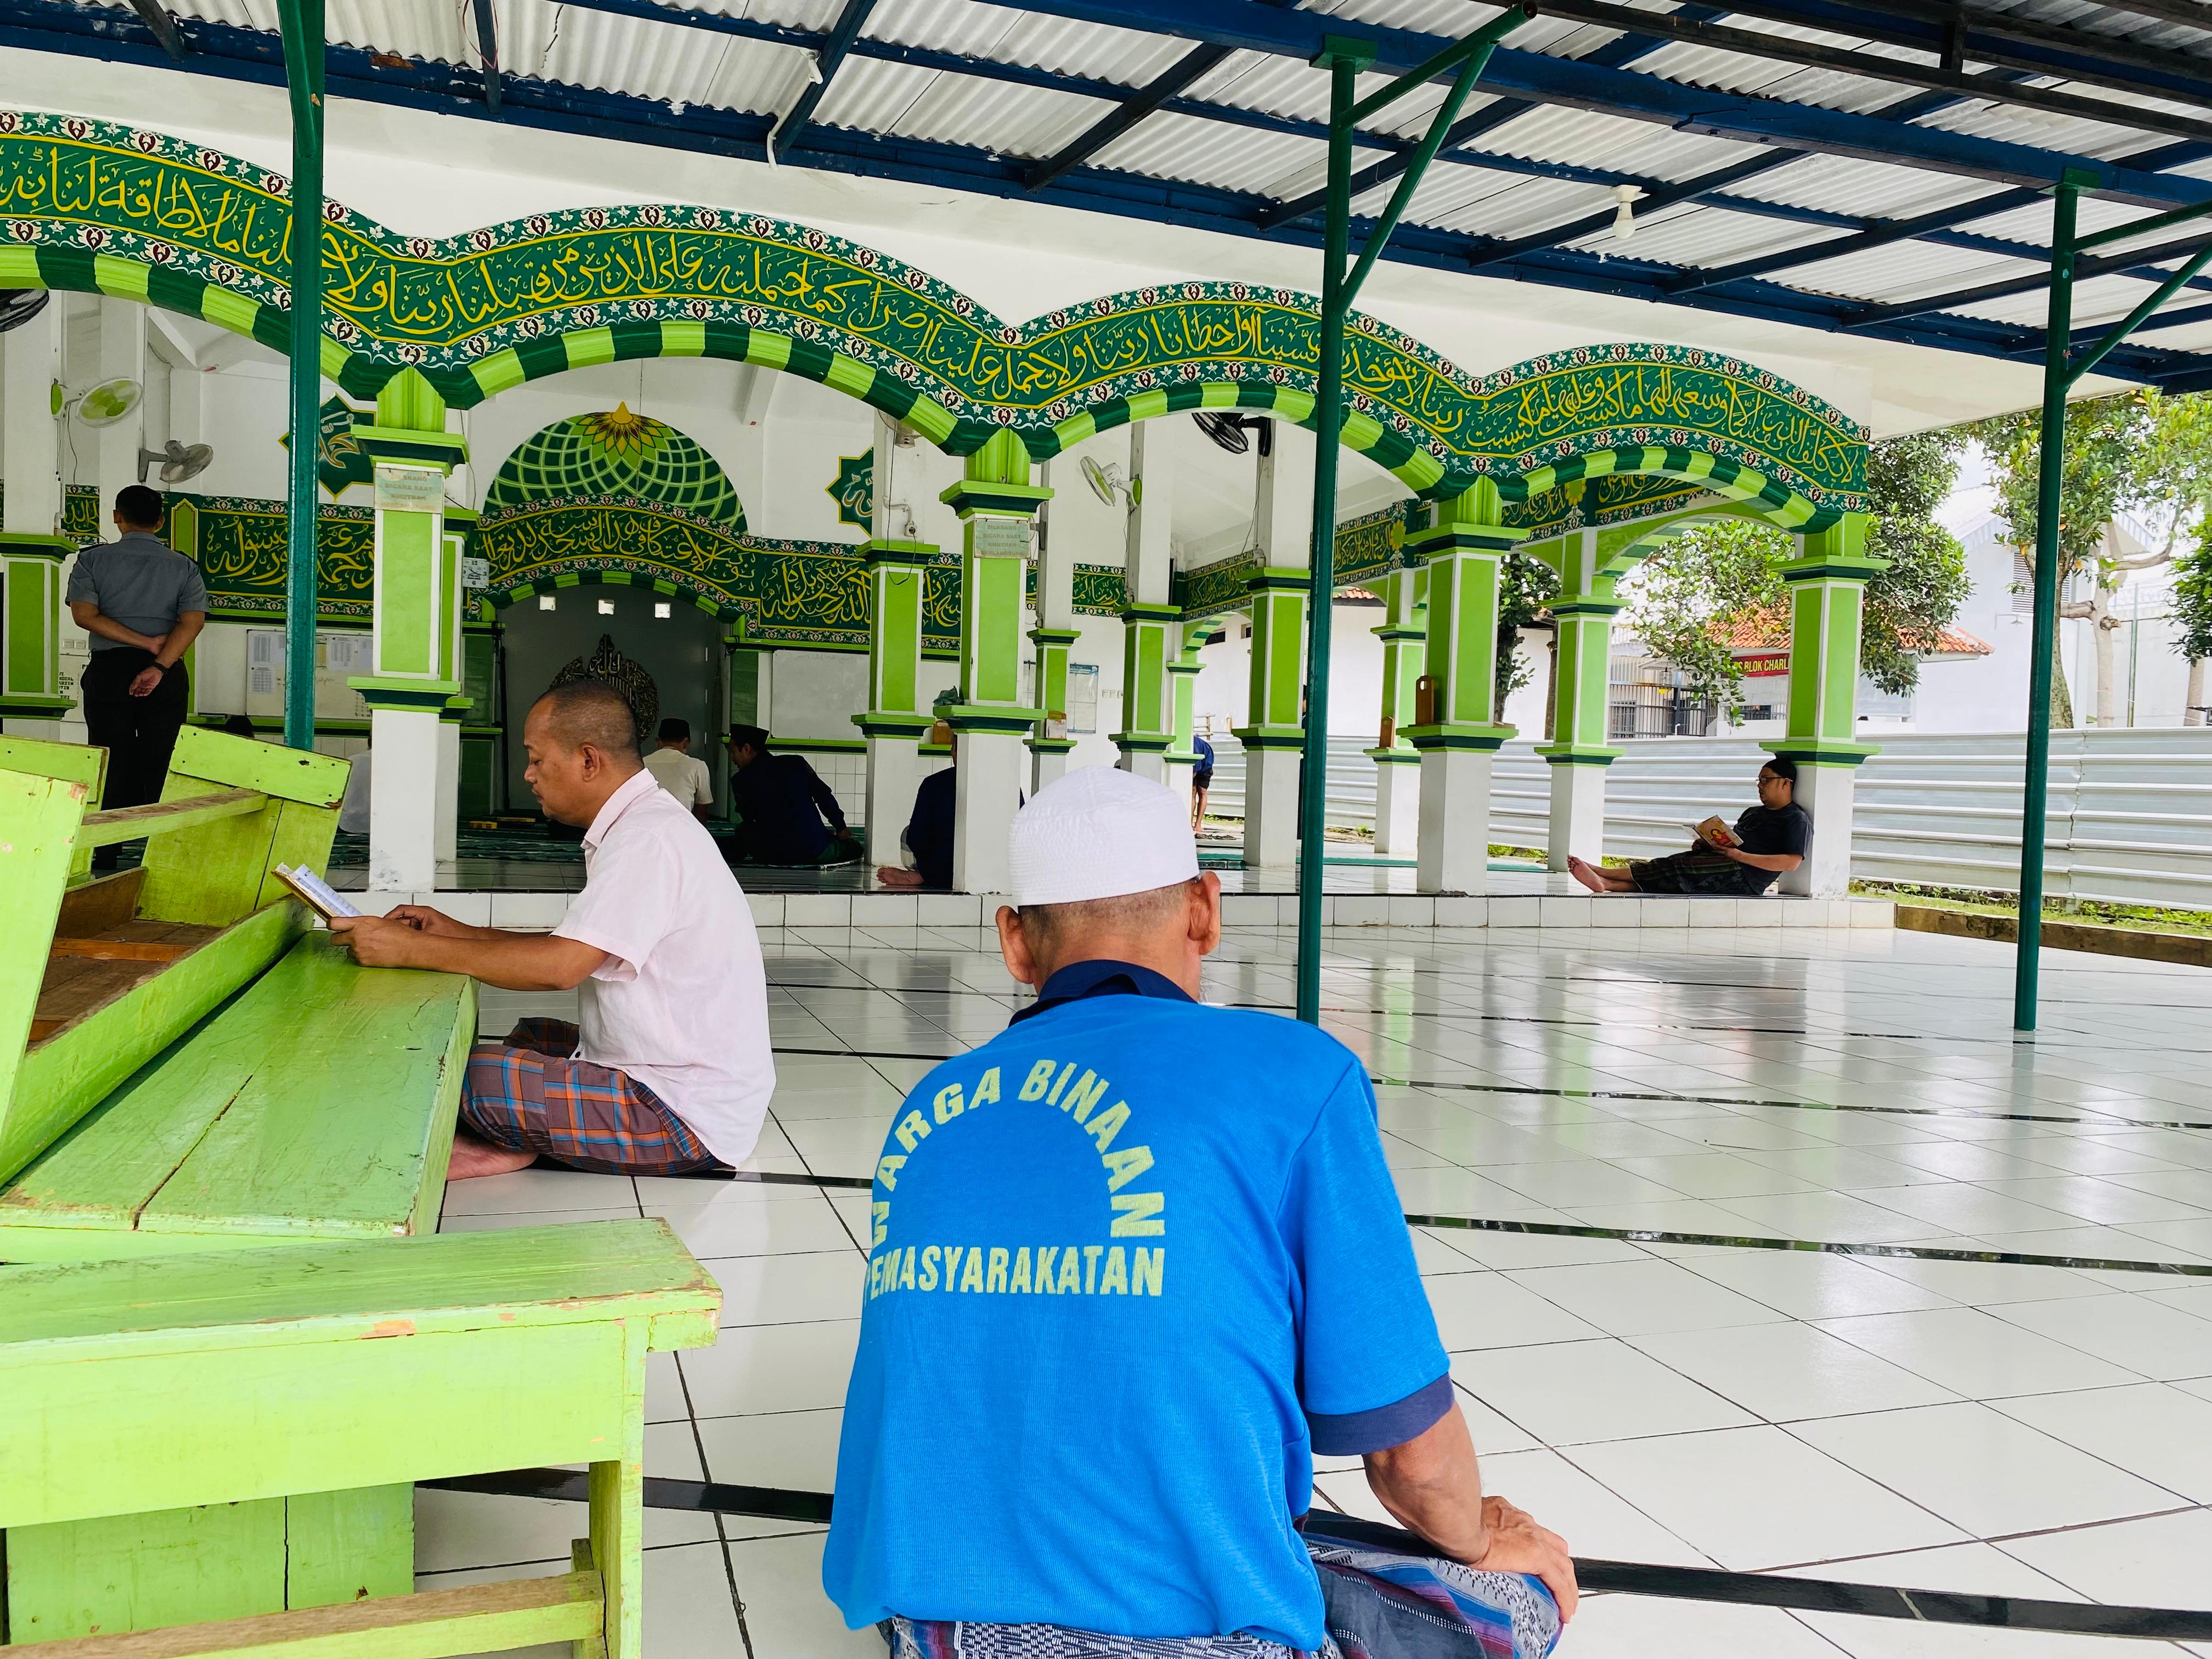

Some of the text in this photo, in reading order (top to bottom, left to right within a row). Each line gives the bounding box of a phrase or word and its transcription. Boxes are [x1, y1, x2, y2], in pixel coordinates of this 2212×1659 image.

[1744, 661, 1763, 673] BLOK
[872, 1059, 1165, 1249] WARGA BINAAN
